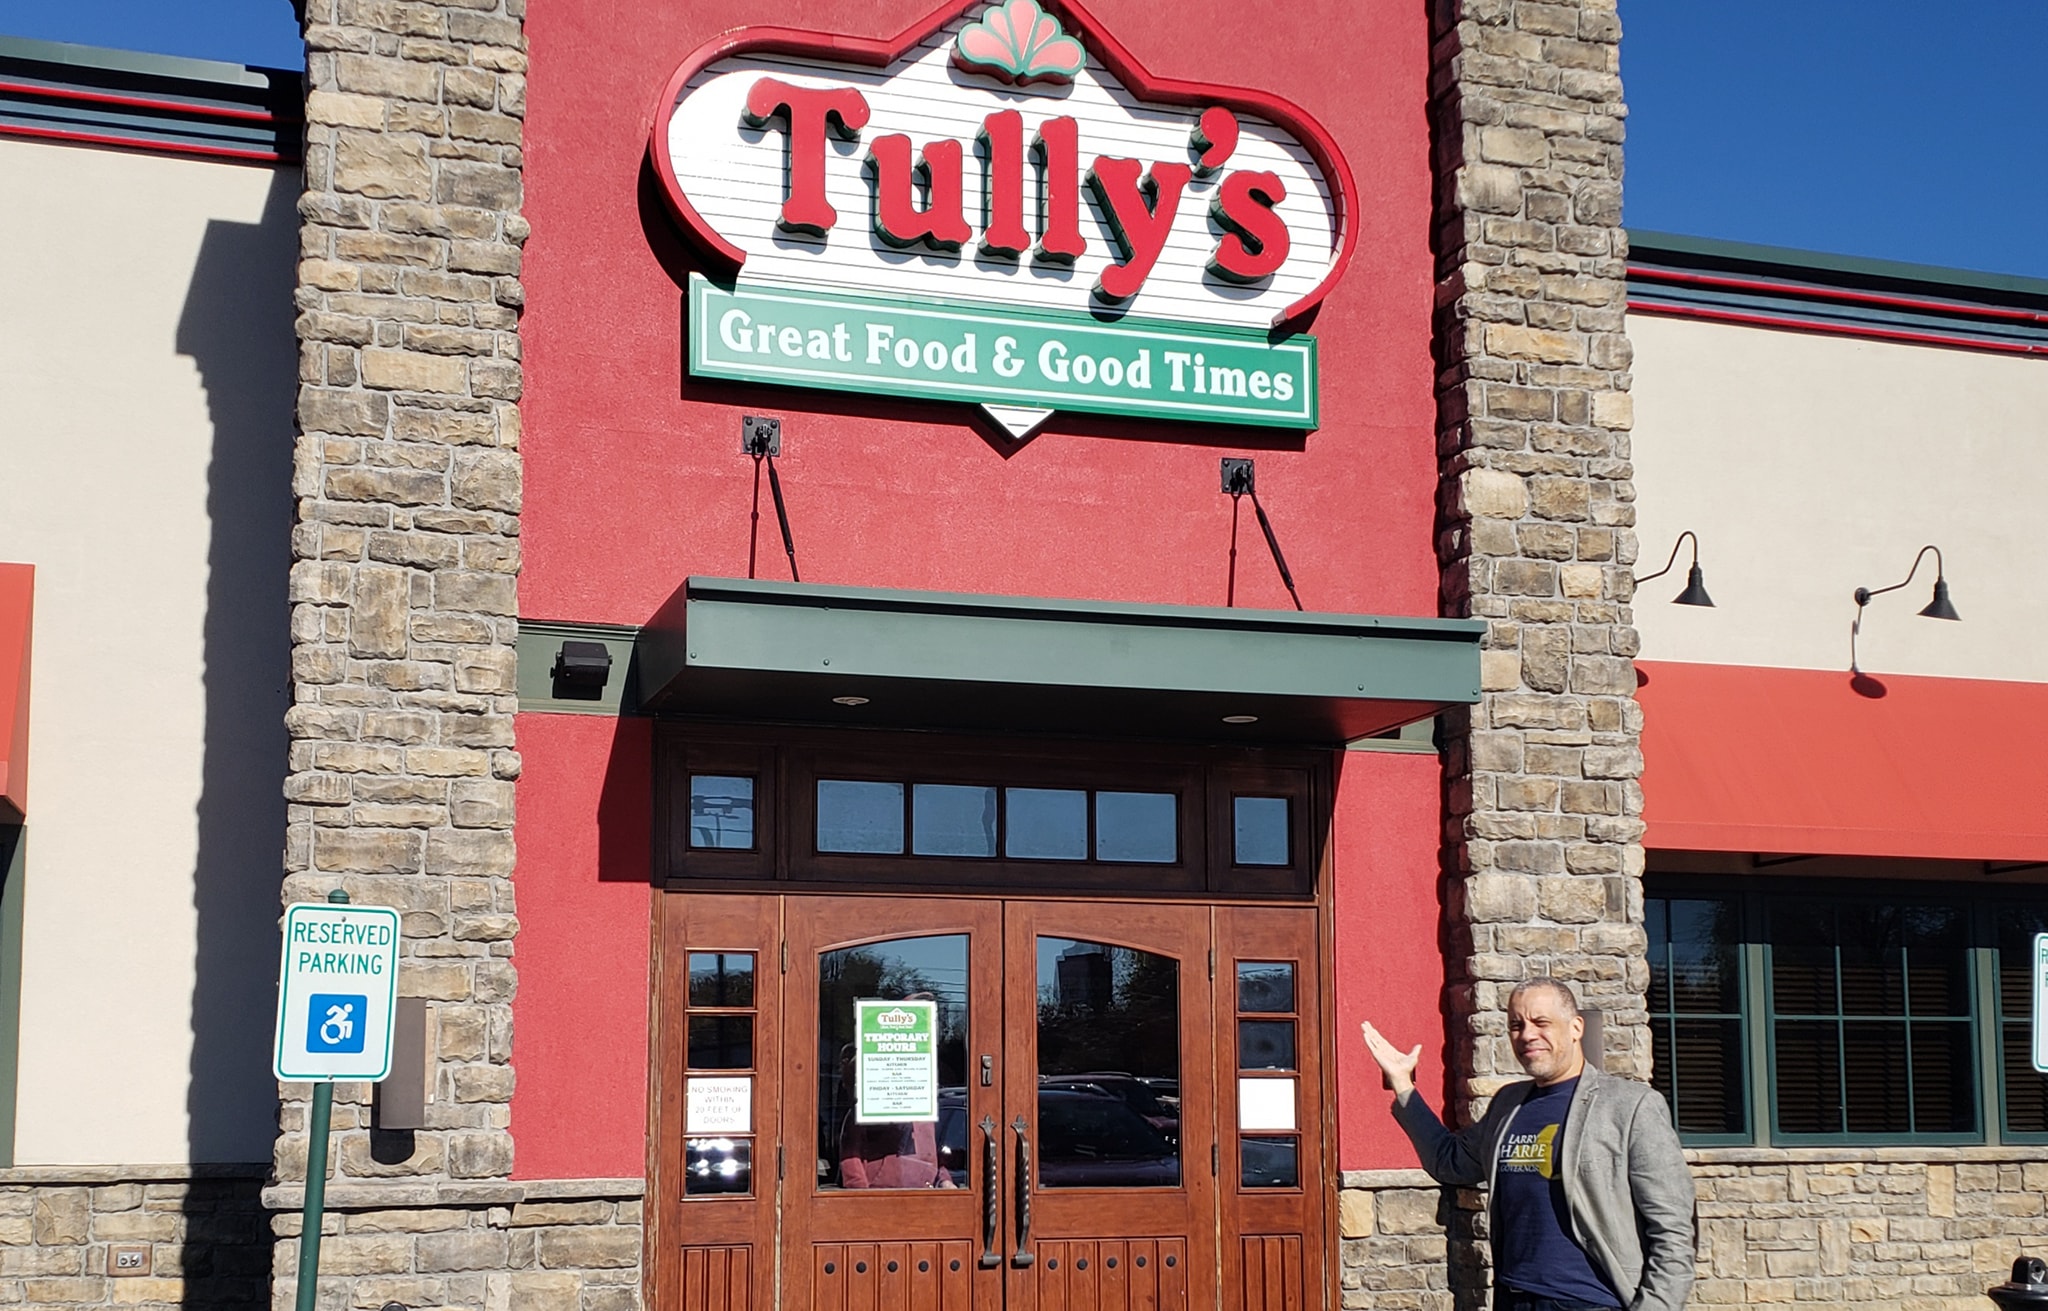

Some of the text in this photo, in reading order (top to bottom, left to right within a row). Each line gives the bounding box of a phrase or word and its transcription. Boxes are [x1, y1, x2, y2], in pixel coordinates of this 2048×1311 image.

[743, 77, 1290, 301] Tully's
[719, 308, 1294, 401] Great Food & Good Times
[294, 921, 391, 945] RESERVED
[298, 951, 383, 975] PARKING
[881, 1013, 914, 1025] Tully's
[863, 1032, 930, 1043] TEMPORARY
[877, 1042, 918, 1053] HOURS
[691, 1085, 748, 1094] NO SMOKING
[707, 1105, 729, 1114] FEET
[703, 1116, 736, 1125] DOORS
[1508, 1133, 1538, 1145] LARRY
[1500, 1143, 1547, 1158] HARPE
